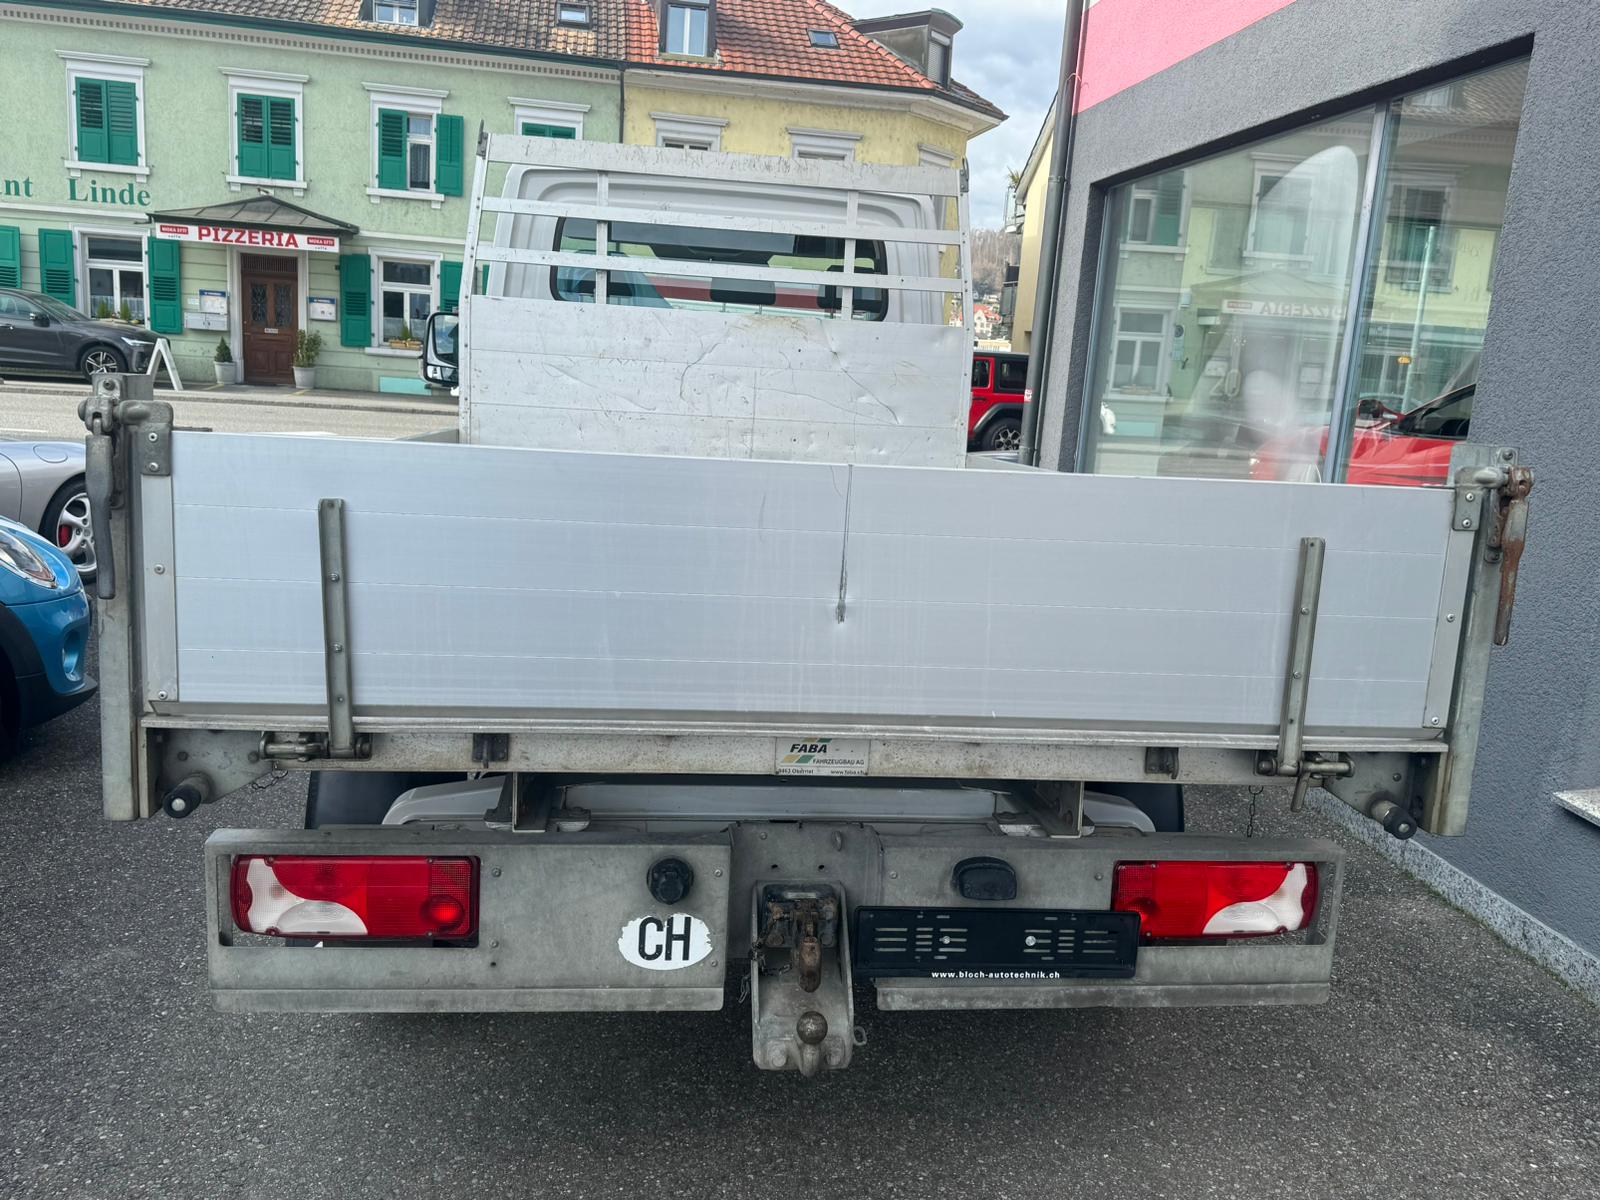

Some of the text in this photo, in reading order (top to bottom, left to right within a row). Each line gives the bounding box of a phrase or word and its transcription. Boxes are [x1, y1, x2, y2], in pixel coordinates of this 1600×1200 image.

[0, 176, 151, 206] nt Linde
[198, 225, 299, 248] PIZZERIA
[790, 743, 828, 753] FABA
[638, 916, 692, 961] CH
[931, 970, 1060, 979] www.bloch-autotechnik.ch
